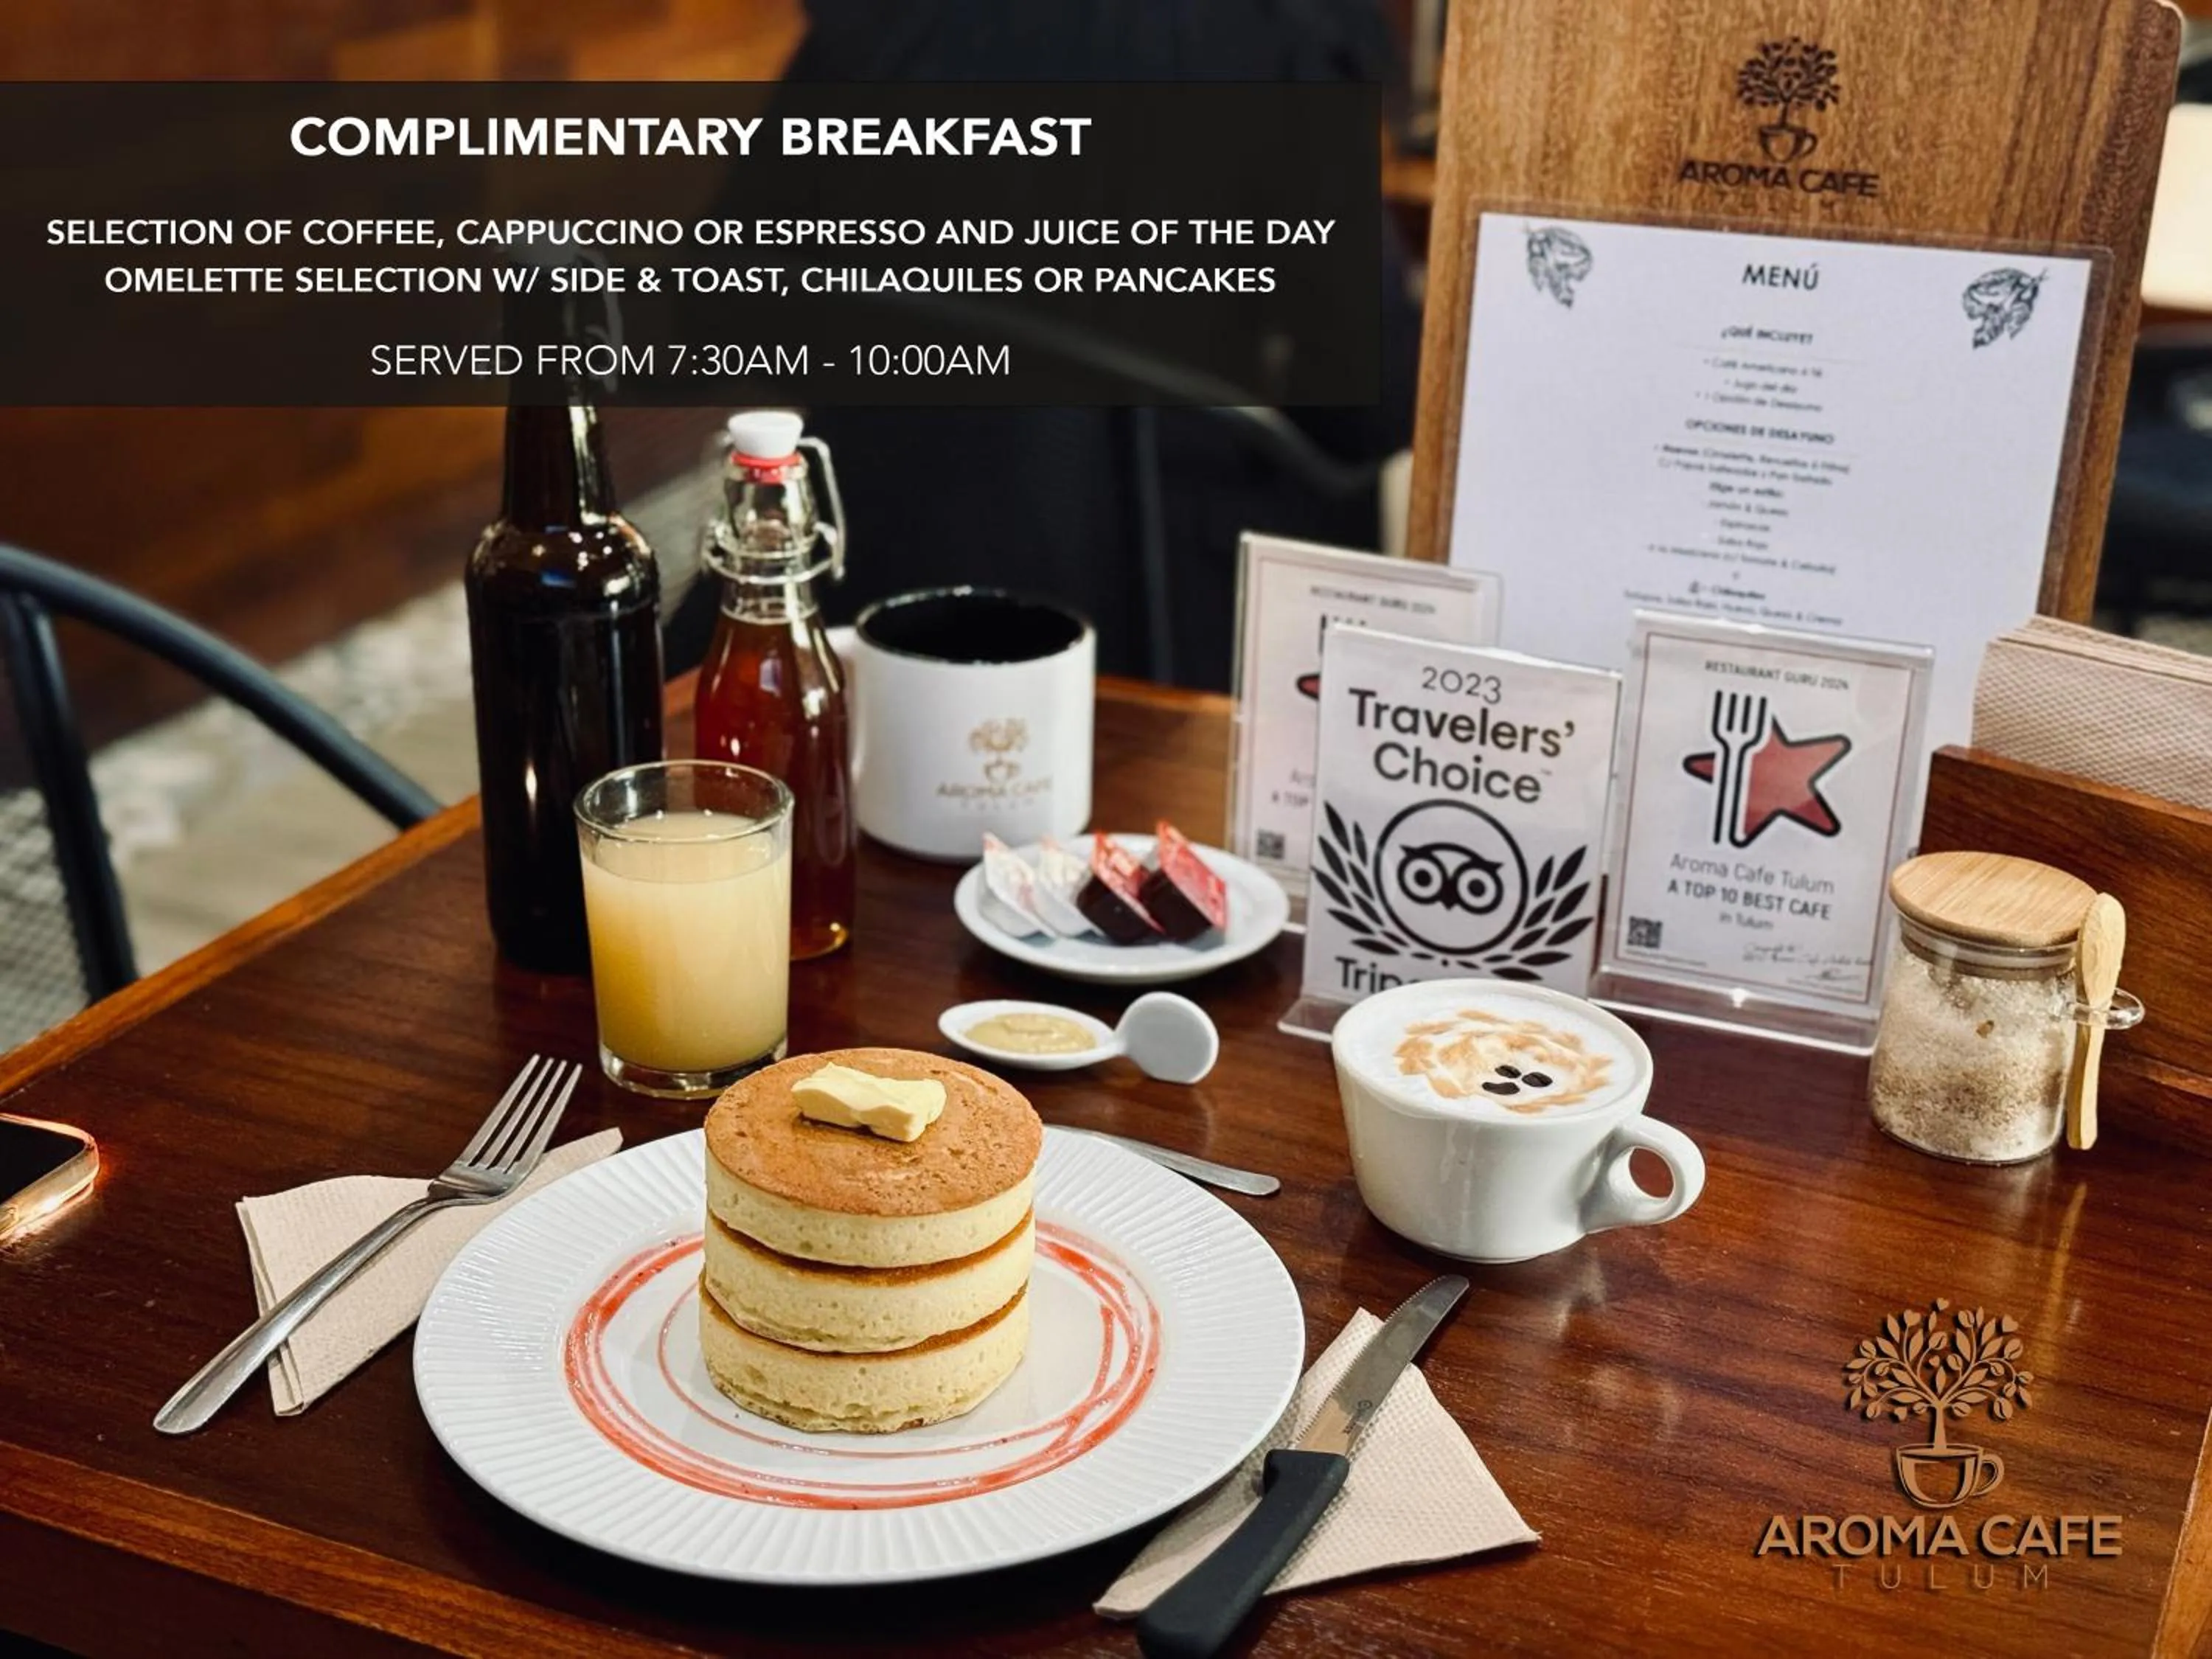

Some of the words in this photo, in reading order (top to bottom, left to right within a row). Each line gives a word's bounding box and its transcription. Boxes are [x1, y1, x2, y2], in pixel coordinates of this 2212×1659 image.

[1679, 159, 1792, 190] AROMA
[1799, 169, 1880, 198] CAFE
[1742, 262, 1820, 291] MENÚ
[1422, 666, 1502, 705] 2023
[1705, 660, 1781, 681] RESTAURANT
[1784, 671, 1819, 686] GURU
[1670, 854, 1729, 878] Aroma
[1734, 863, 1775, 886] Cafe
[1781, 870, 1835, 894] Tulum
[1667, 879, 1679, 894] A
[1685, 880, 1716, 898] TOP
[1721, 887, 1739, 905] 10
[1742, 891, 1785, 912] BEST
[1789, 897, 1833, 921] CAFE
